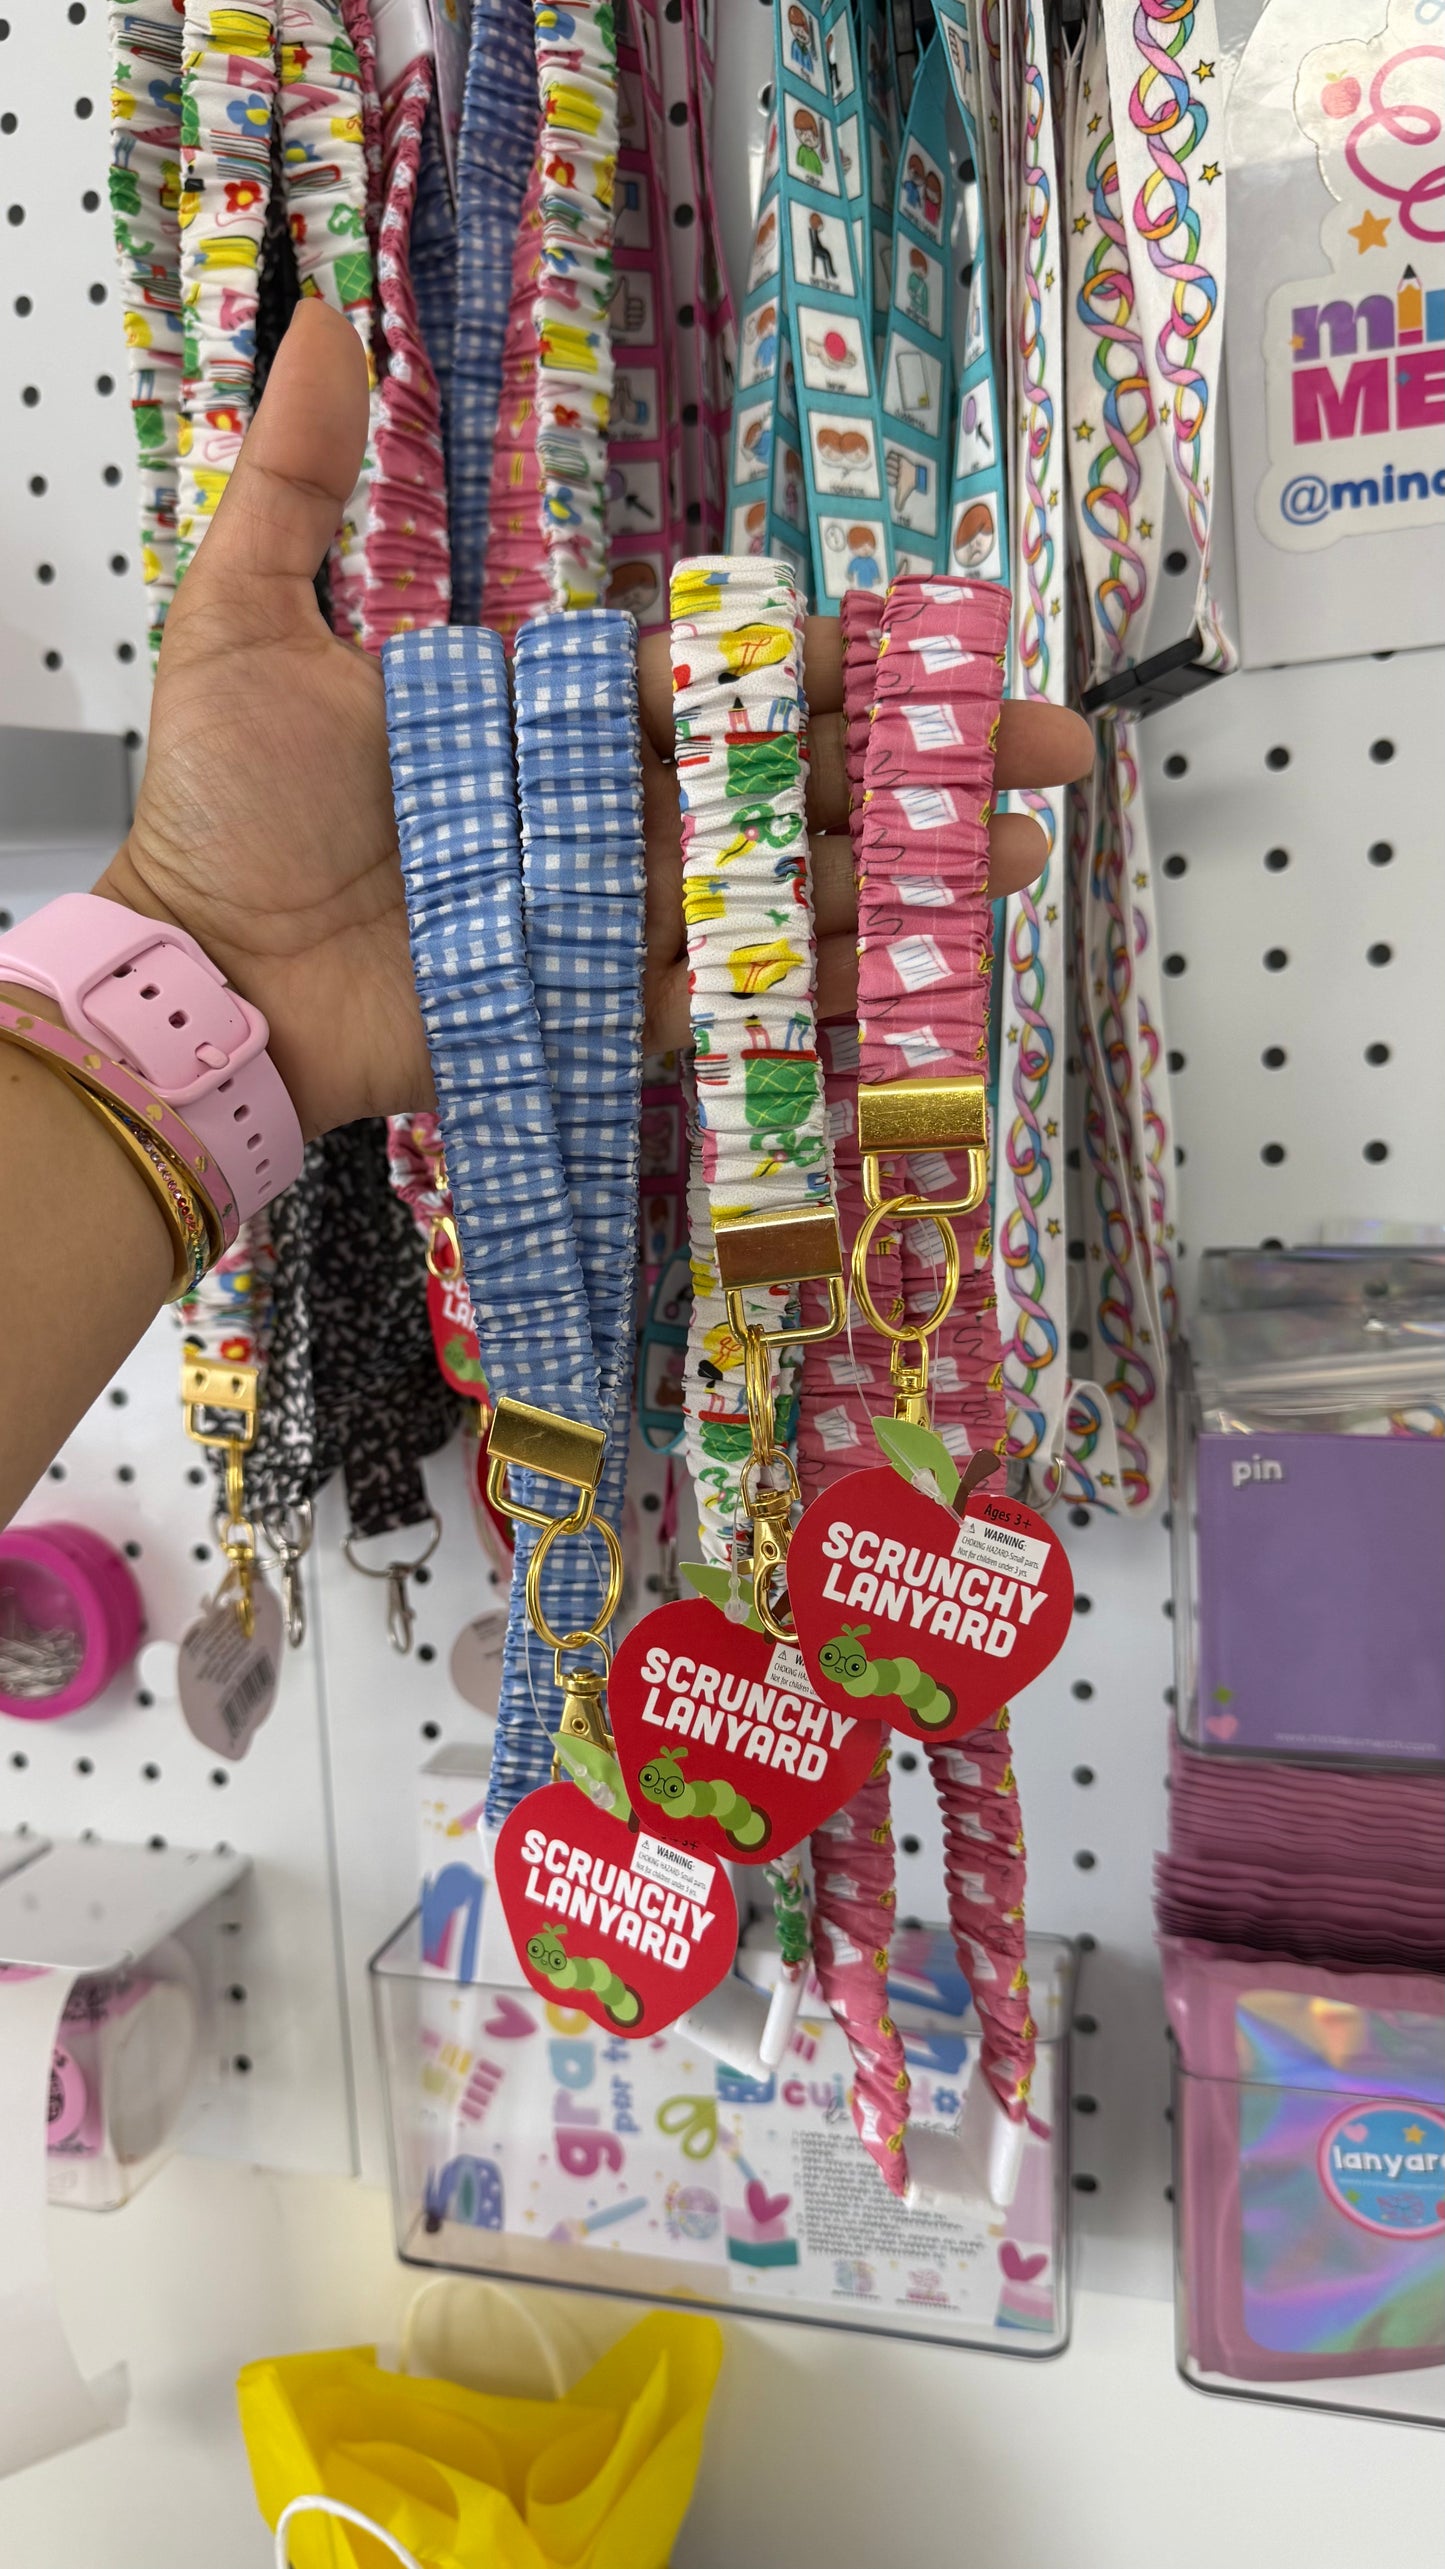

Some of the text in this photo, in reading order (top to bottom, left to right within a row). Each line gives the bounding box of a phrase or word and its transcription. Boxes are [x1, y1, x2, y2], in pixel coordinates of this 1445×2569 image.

[1232, 1453, 1283, 1488] pin
[984, 1503, 1032, 1529] Ages 3+
[961, 1535, 986, 1551] CHOKING
[1023, 1558, 1040, 1569] parts.
[984, 1527, 1027, 1551] WARNING:
[822, 1521, 1048, 1626] SCRUNCHY
[957, 1547, 968, 1557] Not
[968, 1550, 977, 1559] for
[976, 1553, 998, 1567] children
[998, 1561, 1014, 1572] under
[822, 1562, 1017, 1658] LANYARD
[770, 1673, 780, 1683] Not
[780, 1676, 789, 1685] for
[789, 1680, 809, 1692] children
[774, 1662, 797, 1677] CHOKING
[640, 1646, 858, 1750] SCRUNCHY
[641, 1686, 828, 1782] LANYARD
[656, 1845, 695, 1871] WARNING:
[520, 1829, 716, 1943] SCRUNCHY
[524, 1865, 691, 1971] LANYARD
[1332, 2144, 1445, 2179] lanyar
